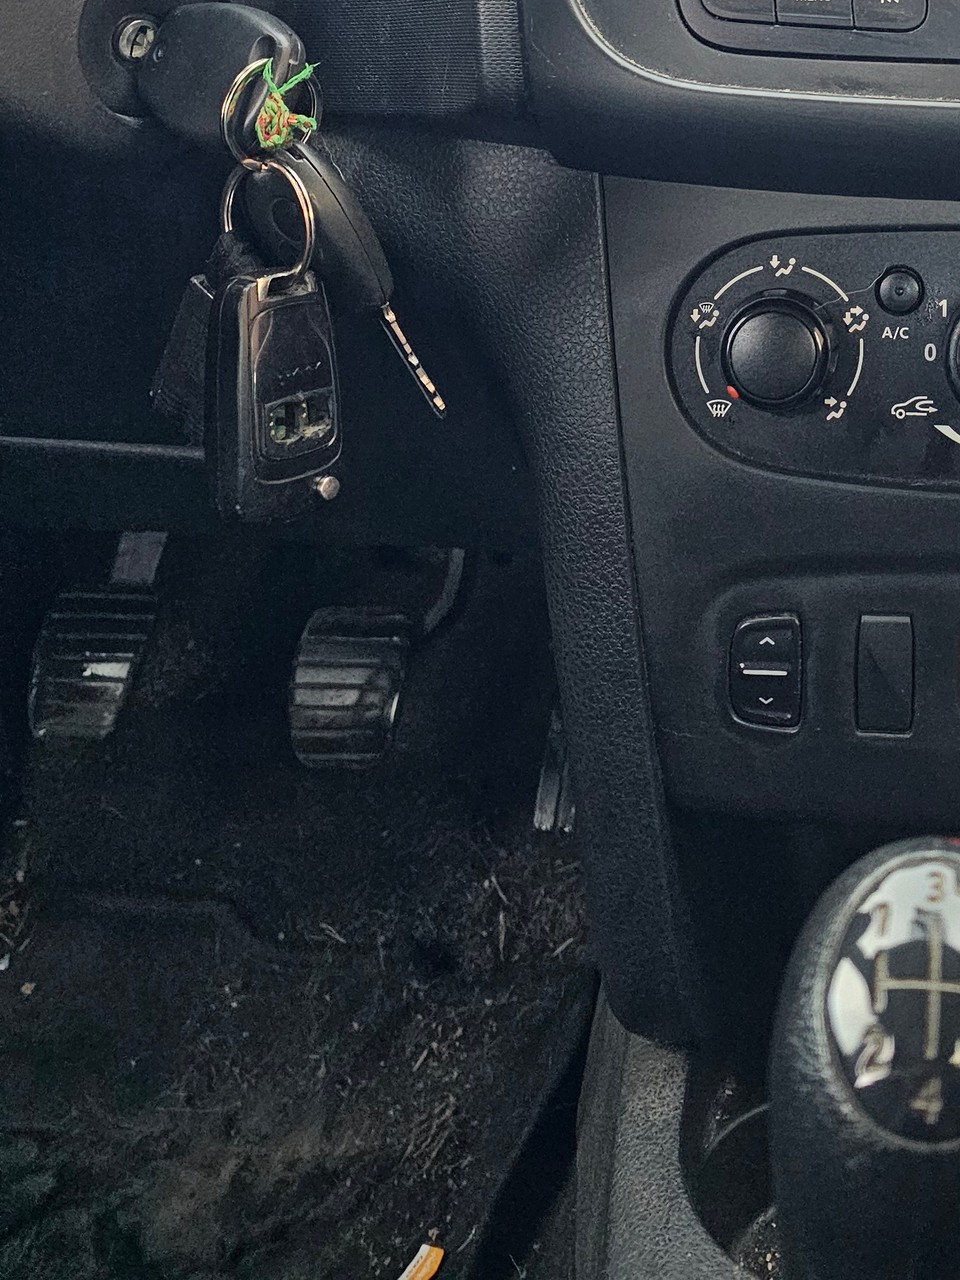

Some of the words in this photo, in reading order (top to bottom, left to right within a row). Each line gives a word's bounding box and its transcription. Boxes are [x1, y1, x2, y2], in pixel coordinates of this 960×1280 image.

[938, 299, 949, 318] 1
[881, 326, 910, 340] A/C
[923, 343, 938, 362] 0
[925, 870, 946, 904] 3
[853, 1026, 895, 1088] 2
[910, 1077, 944, 1125] 4
